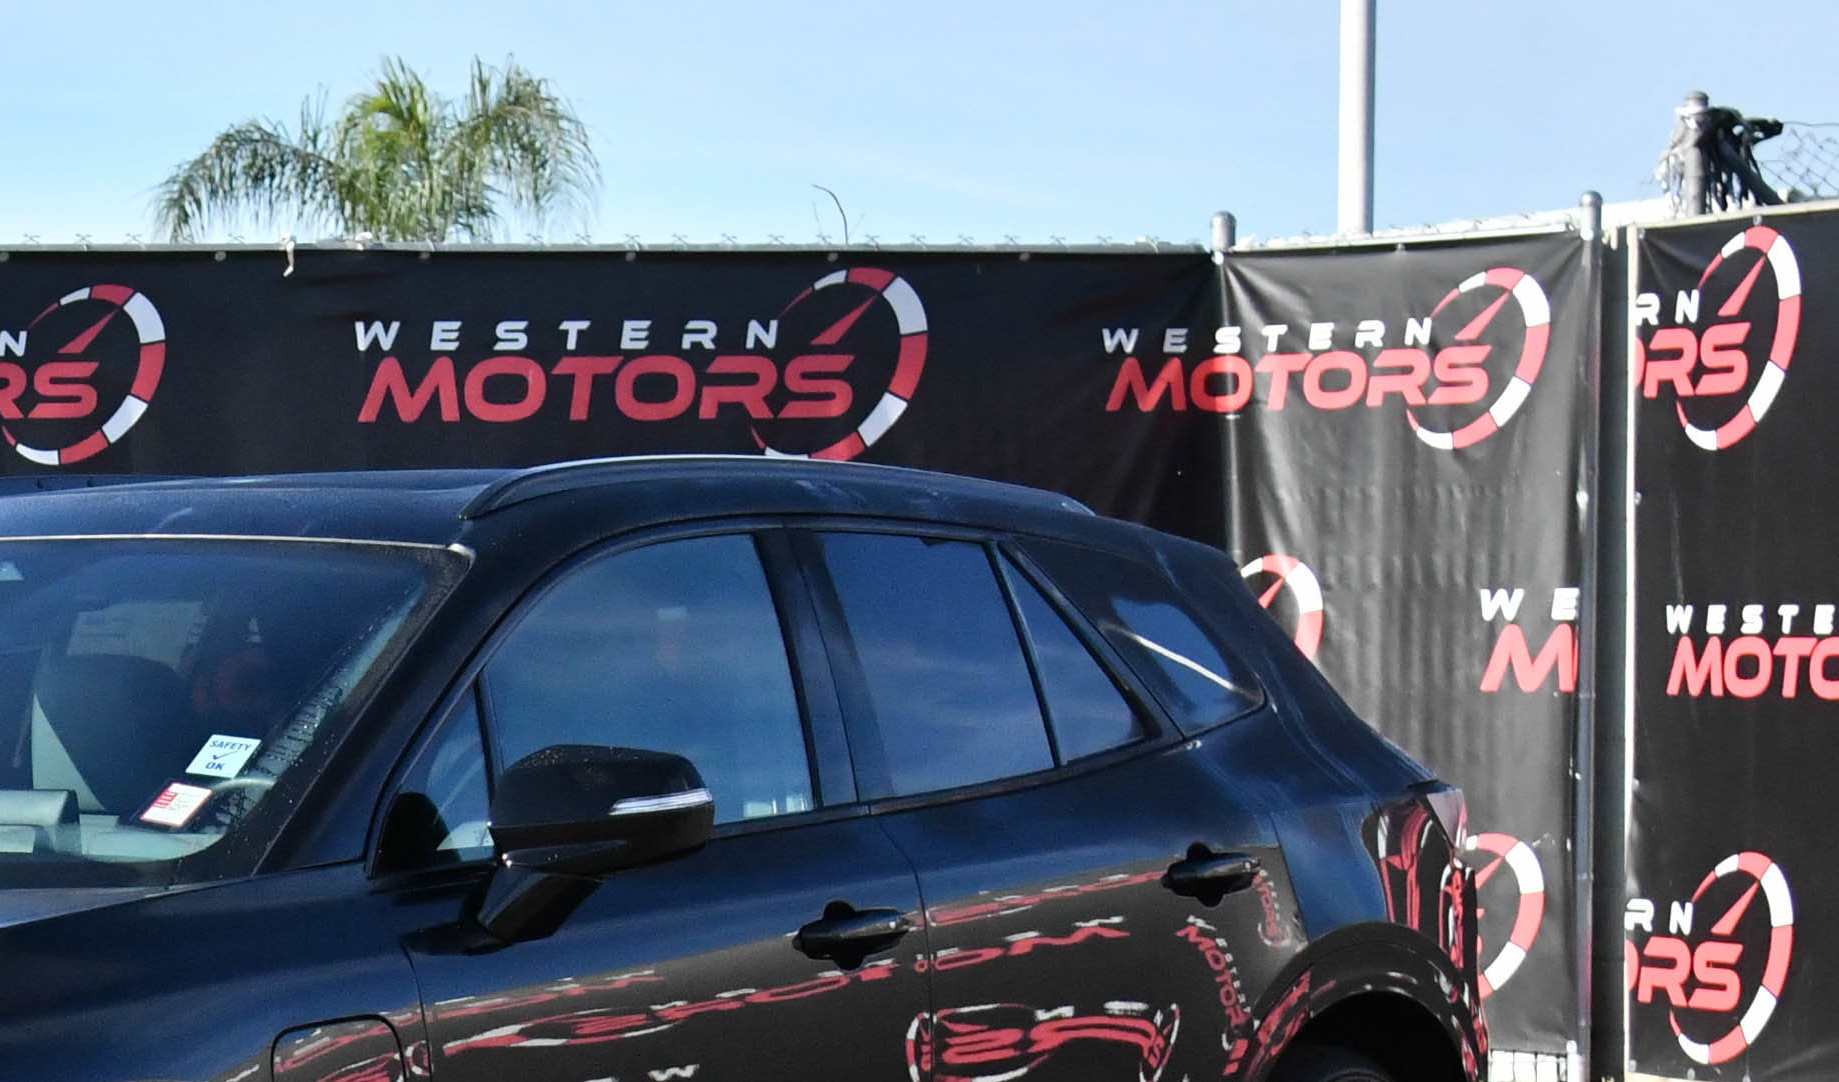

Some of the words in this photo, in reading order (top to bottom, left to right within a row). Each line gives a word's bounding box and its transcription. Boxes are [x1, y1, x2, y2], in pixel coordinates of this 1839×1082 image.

[354, 319, 778, 352] WESTERN
[1102, 316, 1433, 354] WESTERN
[357, 354, 855, 423] MOTORS
[1105, 344, 1493, 414] MOTORS
[209, 740, 252, 751] SAFETY
[205, 761, 225, 771] OK
